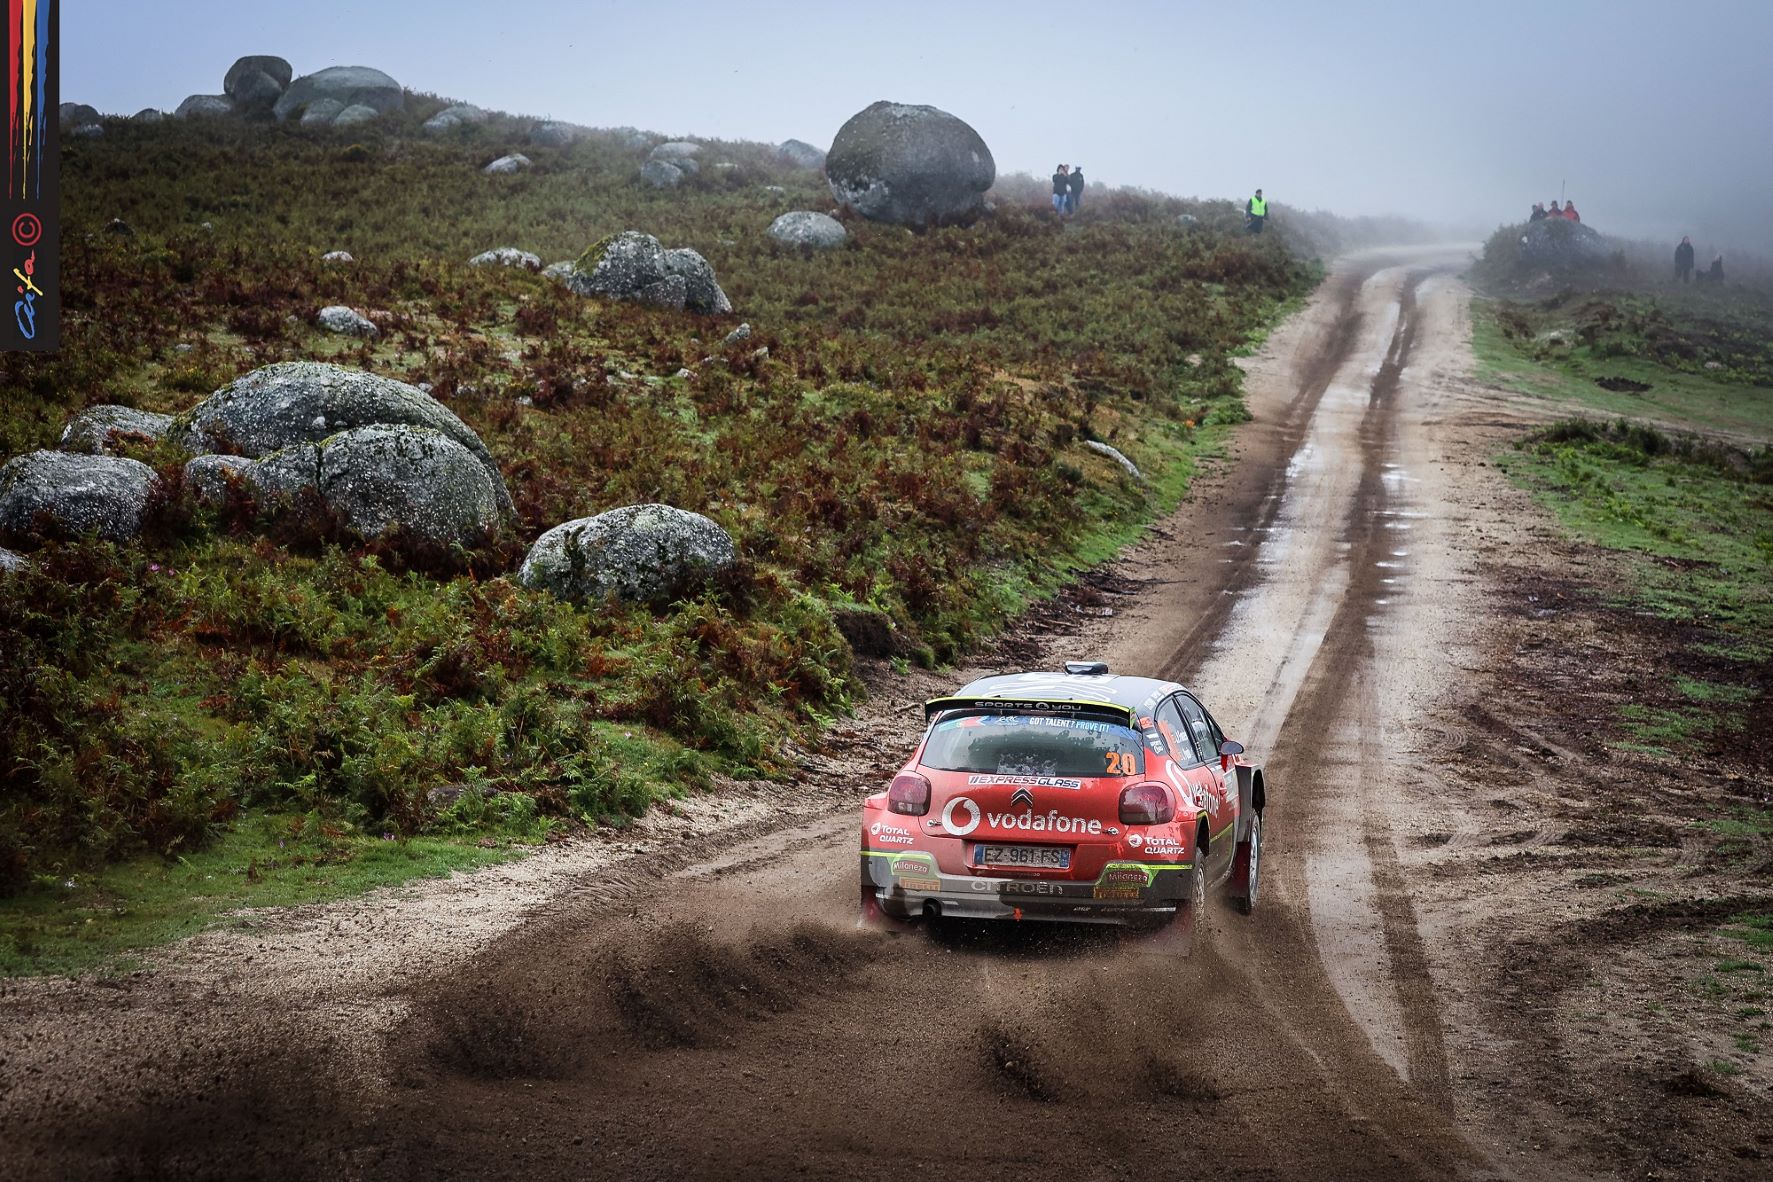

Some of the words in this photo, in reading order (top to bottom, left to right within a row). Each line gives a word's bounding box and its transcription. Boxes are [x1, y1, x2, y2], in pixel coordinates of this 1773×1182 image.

[974, 701, 1033, 709] SPORTS
[1029, 717, 1044, 725] GOT
[1045, 717, 1076, 728] TALENT?
[1075, 721, 1098, 731] PROVE
[1098, 723, 1110, 733] IT!
[1105, 751, 1136, 776] 20
[987, 808, 1102, 835] vodafone
[881, 825, 910, 836] TOTAL
[879, 834, 914, 845] QUARTZ
[1144, 836, 1180, 846] TOTAL
[1144, 846, 1185, 855] QUARTZ
[893, 861, 928, 873] Milaneza
